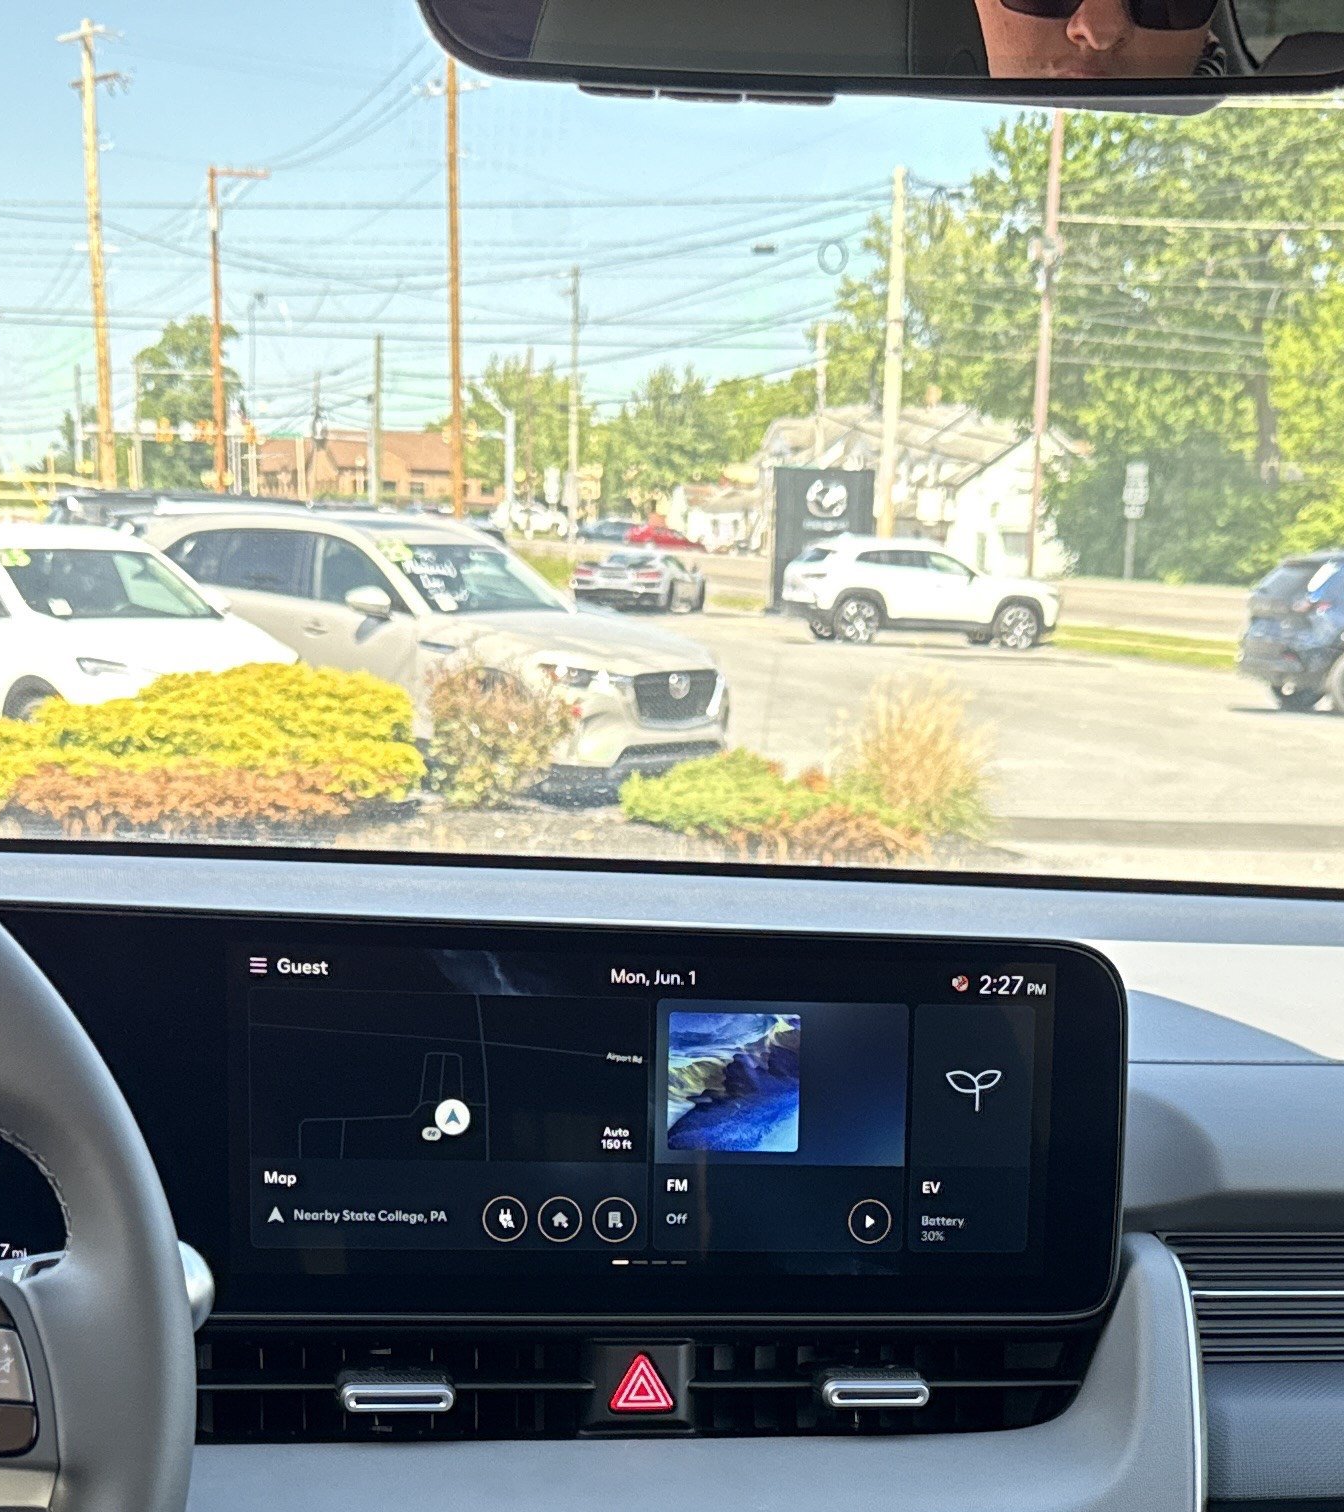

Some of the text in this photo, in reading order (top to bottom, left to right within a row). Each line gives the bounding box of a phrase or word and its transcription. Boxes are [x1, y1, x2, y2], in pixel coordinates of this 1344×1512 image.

[276, 957, 329, 977] Guest
[610, 969, 695, 986] Mon, Jun. 1
[979, 976, 1046, 995] 2:27 PM
[603, 1127, 629, 1138] Auto
[601, 1138, 631, 1150] 150 ft
[264, 1171, 297, 1187] Map
[667, 1180, 688, 1192] FM
[922, 1181, 940, 1193] EV
[294, 1209, 447, 1225] Nearby State College, PA
[666, 1213, 687, 1225] Off
[921, 1215, 964, 1229] Battery
[921, 1231, 944, 1241] 30%
[0, 1244, 10, 1257] 7
